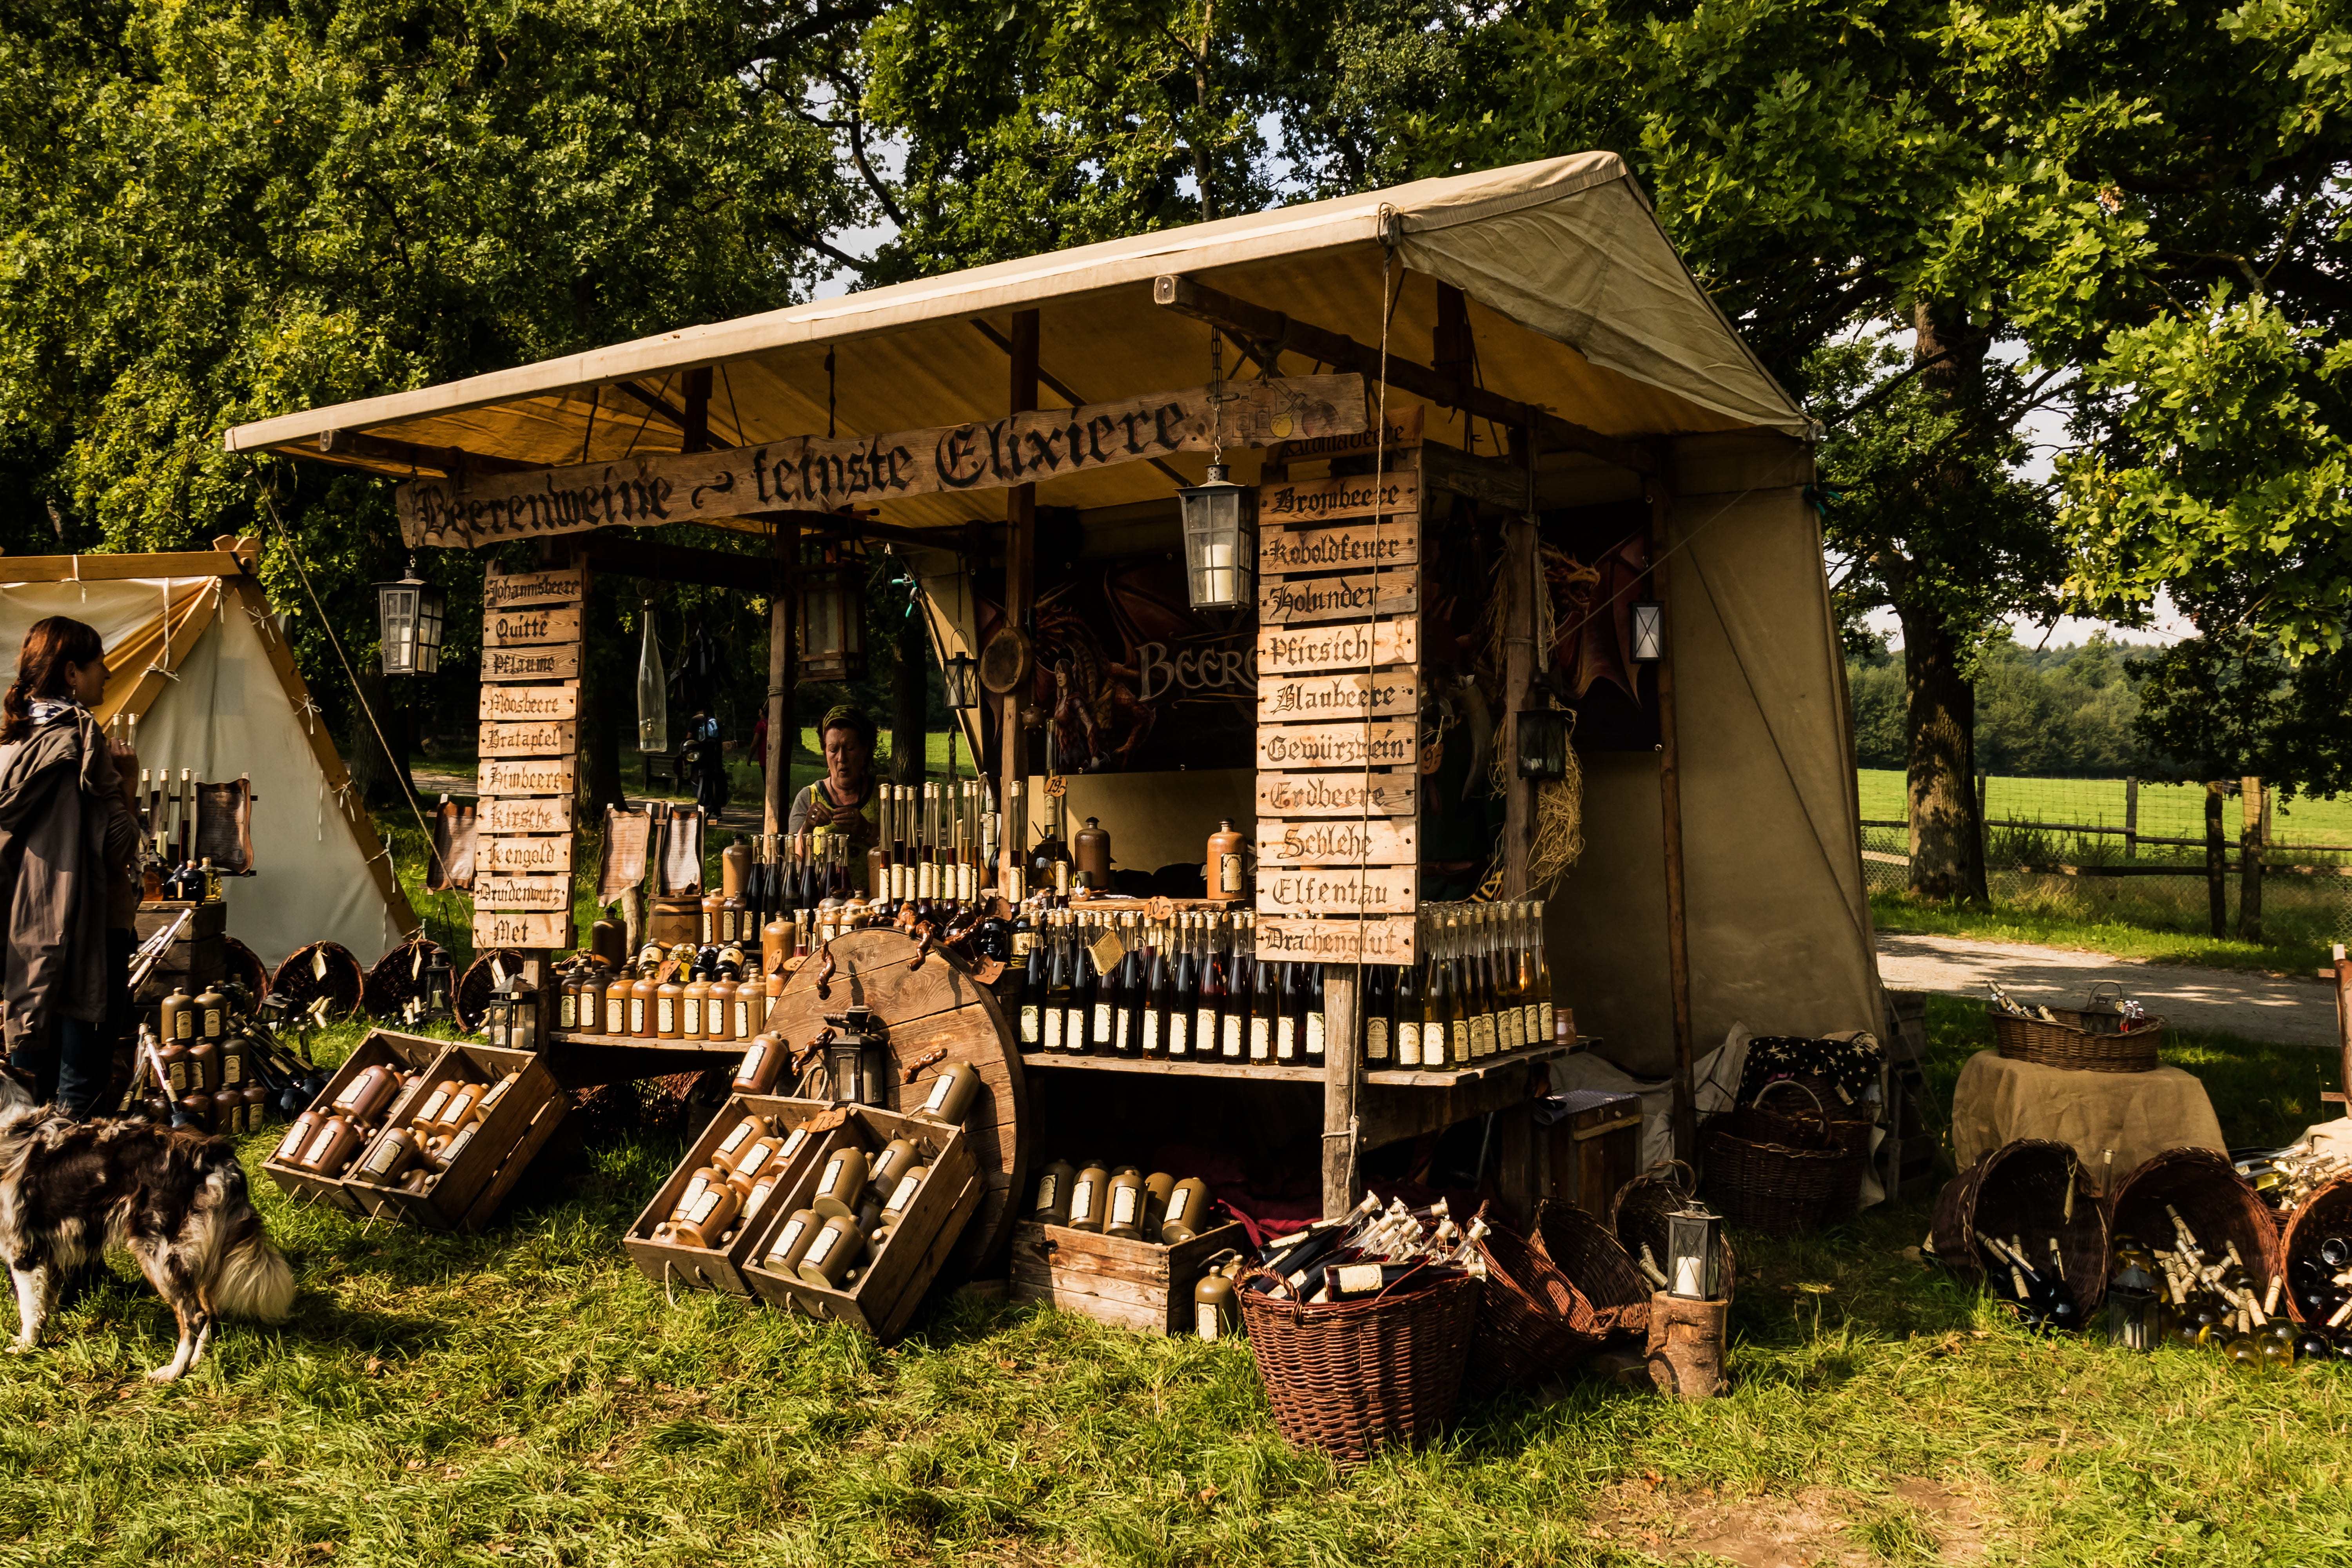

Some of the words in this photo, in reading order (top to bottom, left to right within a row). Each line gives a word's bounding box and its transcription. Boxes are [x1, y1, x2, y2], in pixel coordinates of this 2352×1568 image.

[418, 466, 673, 537] Beerenweine
[936, 402, 1187, 488] Elixiere
[1270, 481, 1400, 513] Brombeere
[1268, 534, 1401, 568] Koboldfeuer
[487, 574, 580, 601] Johannisbeere
[1269, 578, 1379, 622] Holunder
[496, 615, 548, 638] Quitte
[1270, 625, 1369, 665] Pfirsich
[493, 653, 555, 675] Pflaume
[487, 689, 560, 715] Moosbeere
[1270, 677, 1396, 715] Blaubeere
[486, 726, 563, 751] Bratapfel
[1267, 729, 1404, 765] Gewürzwein
[489, 765, 561, 793] Himbeere
[1270, 777, 1385, 809] Erdbeere
[490, 802, 552, 830] Kirsche
[1277, 824, 1374, 863] Schlehe
[478, 880, 561, 908] Druidenwurz
[1273, 876, 1388, 905] Elfentau
[494, 918, 529, 943] Met
[1265, 924, 1398, 961] Drachenglut
